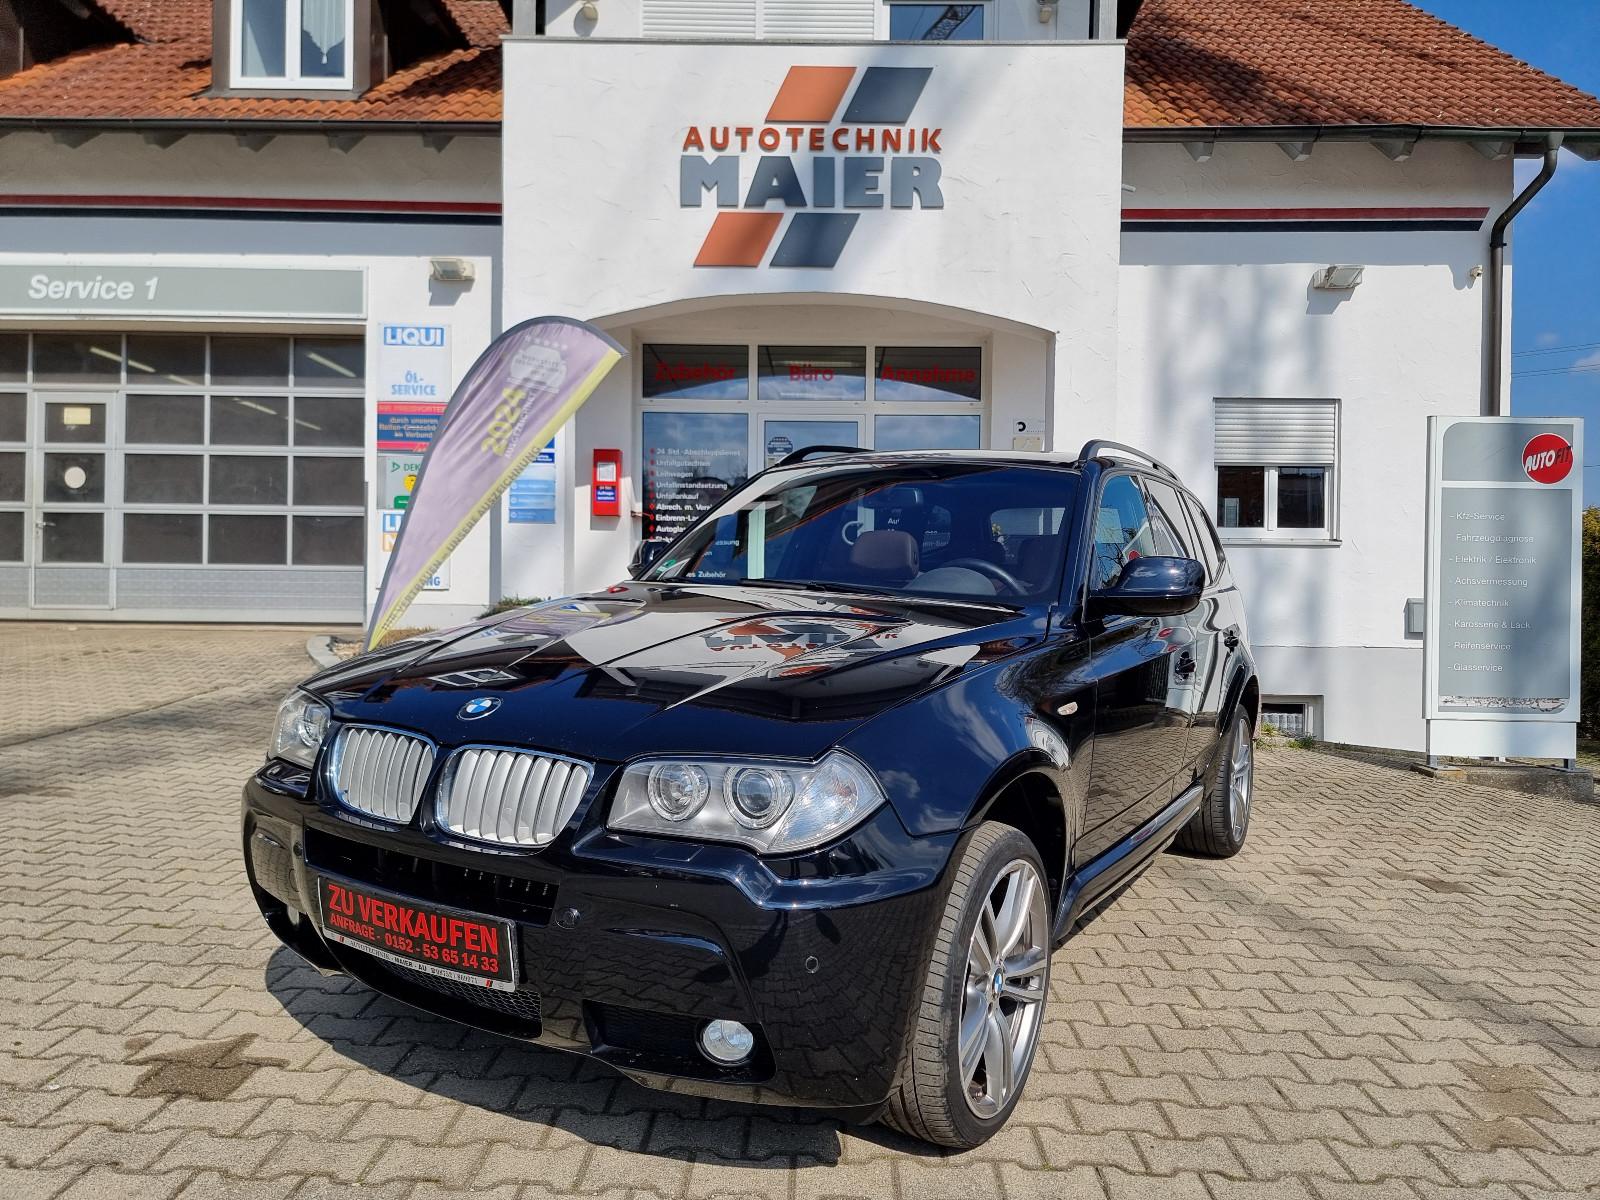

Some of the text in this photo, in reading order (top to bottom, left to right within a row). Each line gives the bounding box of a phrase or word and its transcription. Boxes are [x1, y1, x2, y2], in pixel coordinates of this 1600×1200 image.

[682, 126, 943, 153] AUTOTECHNIK
[680, 154, 945, 210] MAIER
[28, 273, 160, 300] Service 1
[384, 326, 445, 347] LIQUI
[789, 363, 834, 382] Büro
[881, 364, 977, 383] Annahme
[391, 384, 437, 396] SERVICE
[481, 386, 527, 457] 2024
[477, 445, 542, 519] AUSZEICHNUNG
[656, 503, 683, 511] Abrech.
[1456, 512, 1505, 521] Kfz-Service
[656, 525, 687, 534] Autogla
[1455, 533, 1535, 544] Fahrzeugdiagnose
[1455, 555, 1487, 564] Elektrik
[1495, 556, 1537, 565] Elektronik
[698, 570, 727, 578] Zubehör
[1454, 577, 1528, 588] Achsvermessung
[1454, 598, 1510, 608] Klimatechnik
[1453, 619, 1499, 629] Karosserie
[1510, 620, 1532, 630] Lack
[1453, 641, 1511, 651] Reifenservice
[1453, 662, 1503, 673] Glasservice
[328, 883, 500, 956] ZU VERKAUFEN
[329, 912, 376, 942] ANFRAGE
[384, 932, 414, 953] 0152
[423, 943, 439, 960] 53
[441, 948, 459, 965] 65
[461, 952, 479, 969] 14
[481, 956, 499, 973] 33
